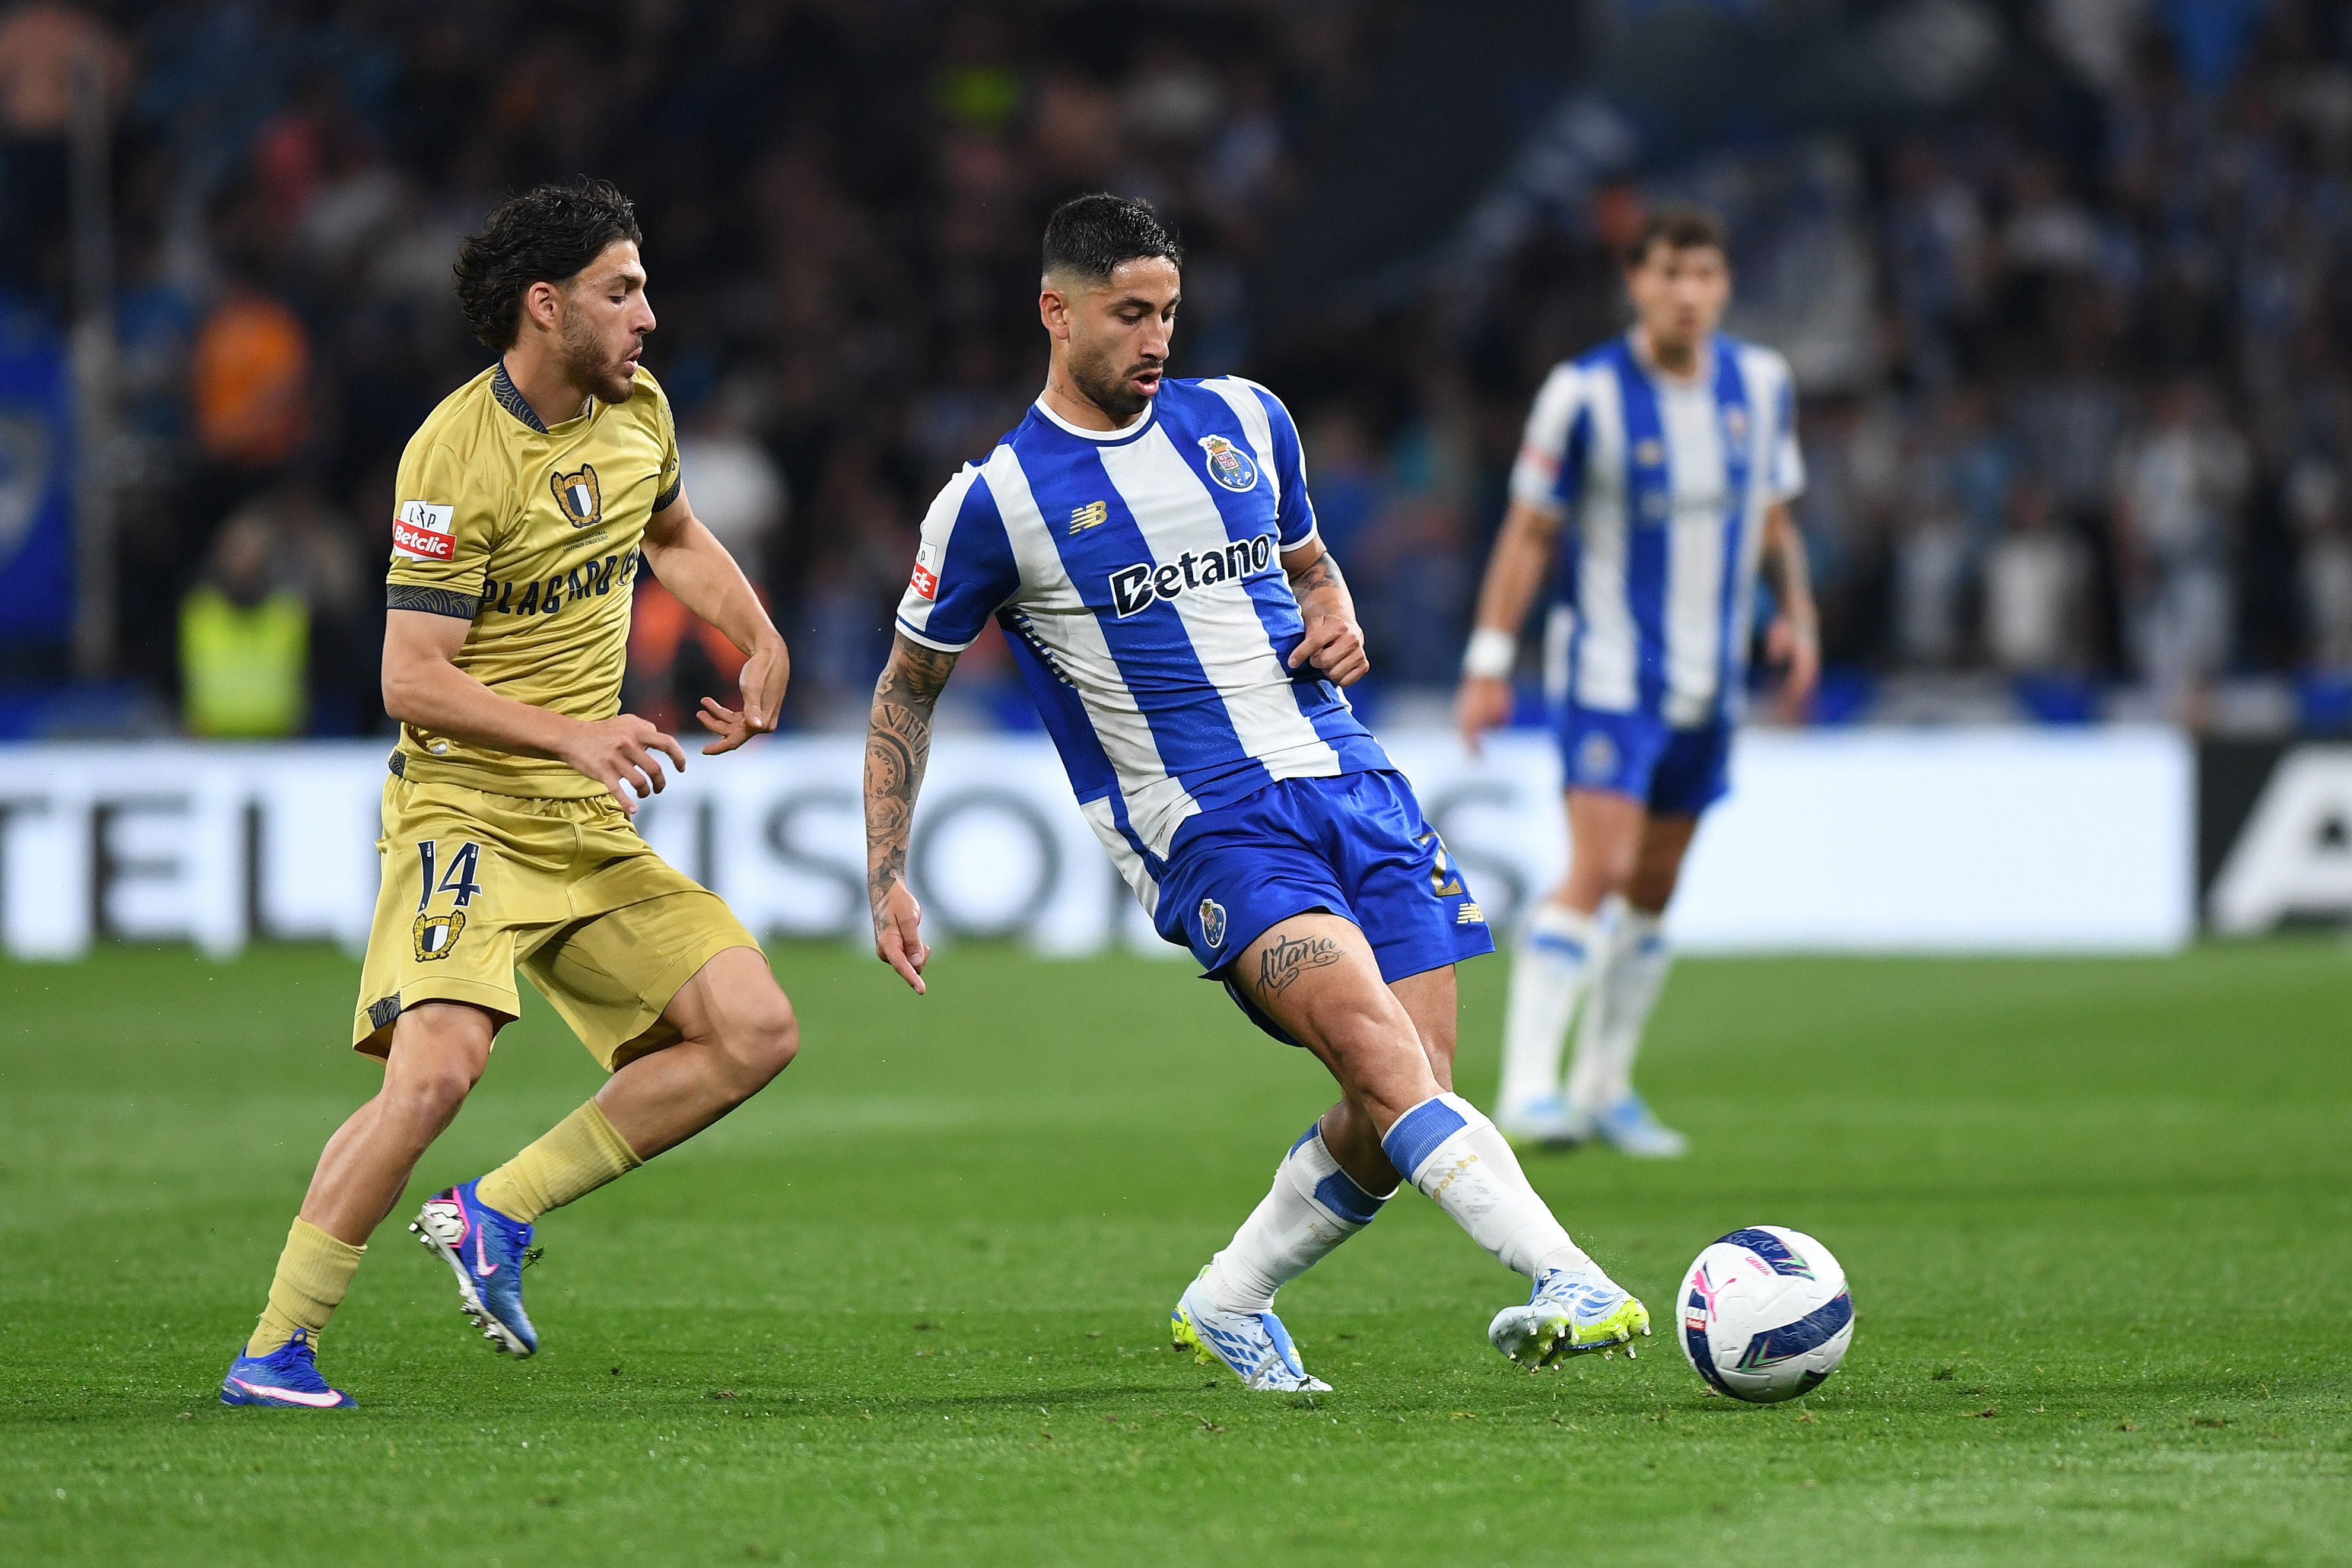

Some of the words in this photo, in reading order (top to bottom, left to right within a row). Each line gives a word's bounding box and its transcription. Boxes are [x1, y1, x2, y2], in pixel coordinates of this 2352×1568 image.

[568, 476, 579, 485] FCF
[1222, 471, 1252, 486] FCP
[395, 524, 449, 555] Betclic
[1110, 535, 1270, 618] Betano
[415, 839, 483, 915] 14
[1256, 934, 1337, 1004] Aitana
